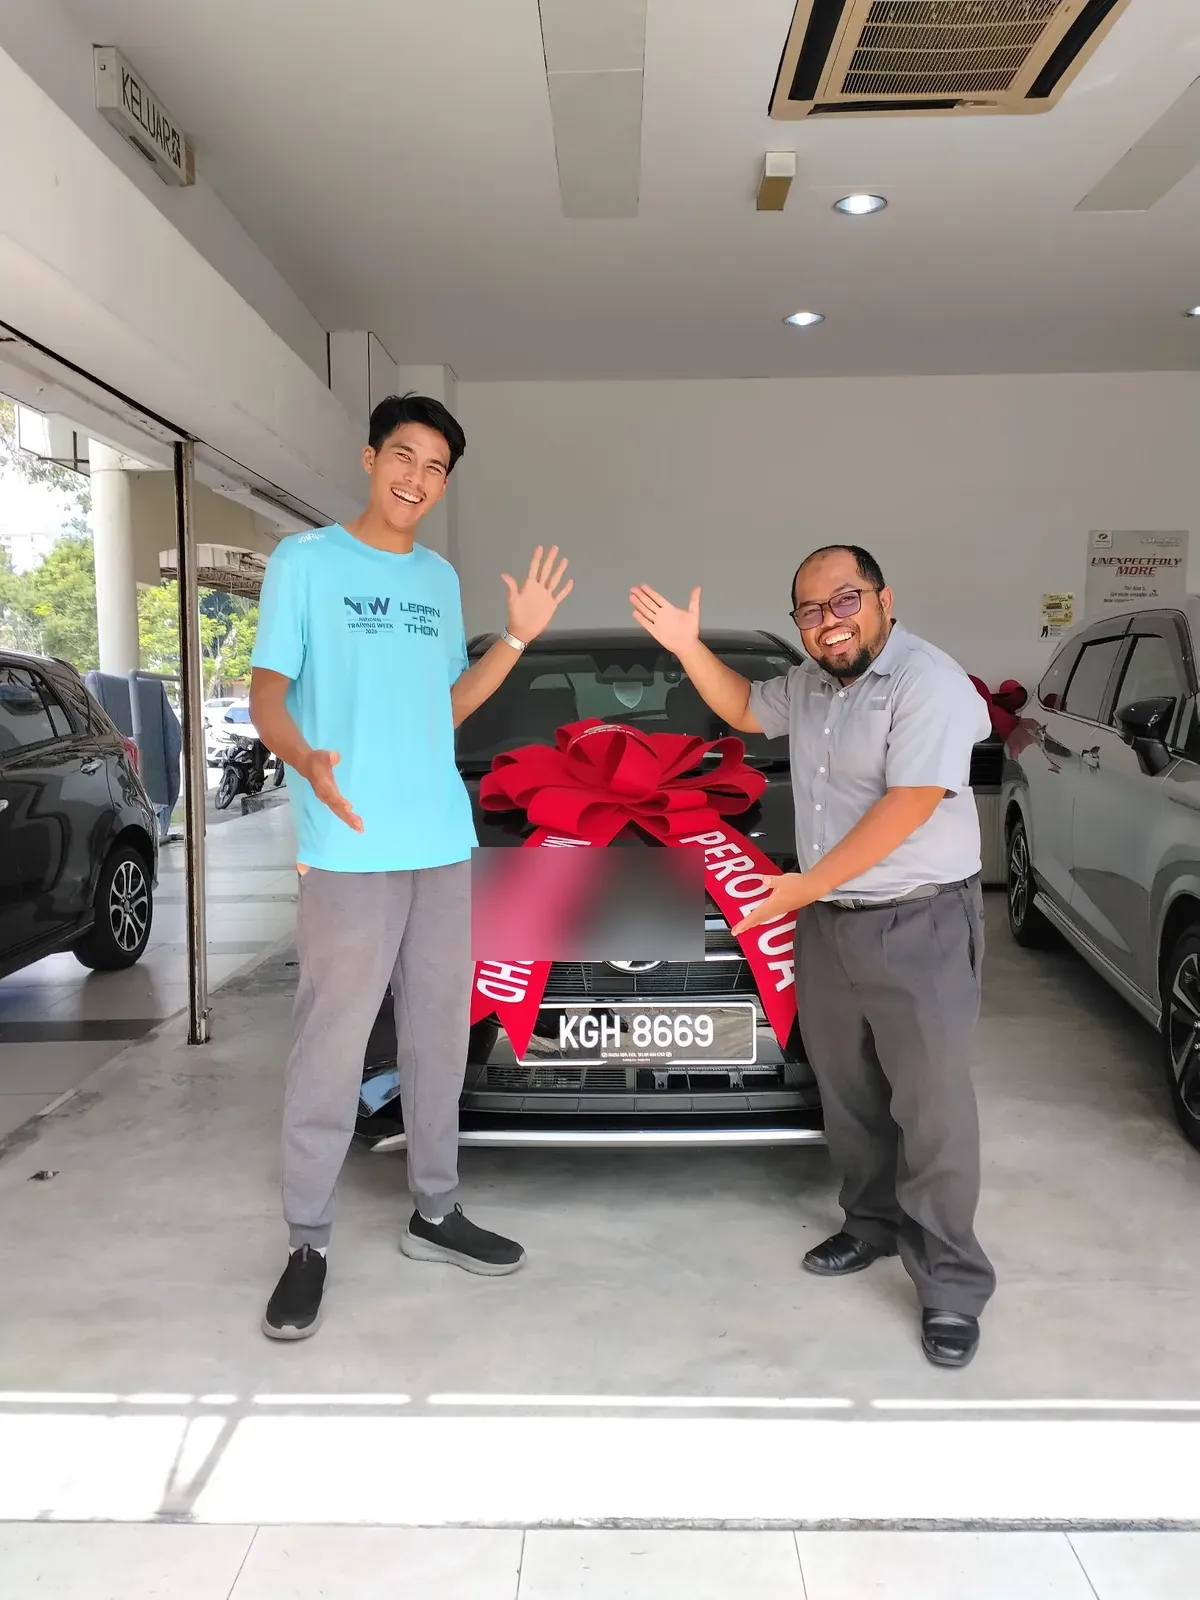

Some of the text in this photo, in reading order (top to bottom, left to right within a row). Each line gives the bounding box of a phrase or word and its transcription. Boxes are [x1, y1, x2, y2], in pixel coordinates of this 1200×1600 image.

[121, 66, 172, 158] KELUAR
[1091, 557, 1182, 566] UNEXPECTEDLY
[1116, 566, 1157, 575] MORE
[343, 596, 391, 616] NTW
[400, 602, 440, 618] LEARN
[404, 623, 439, 637] THON
[559, 1014, 714, 1049] KGH 8669
